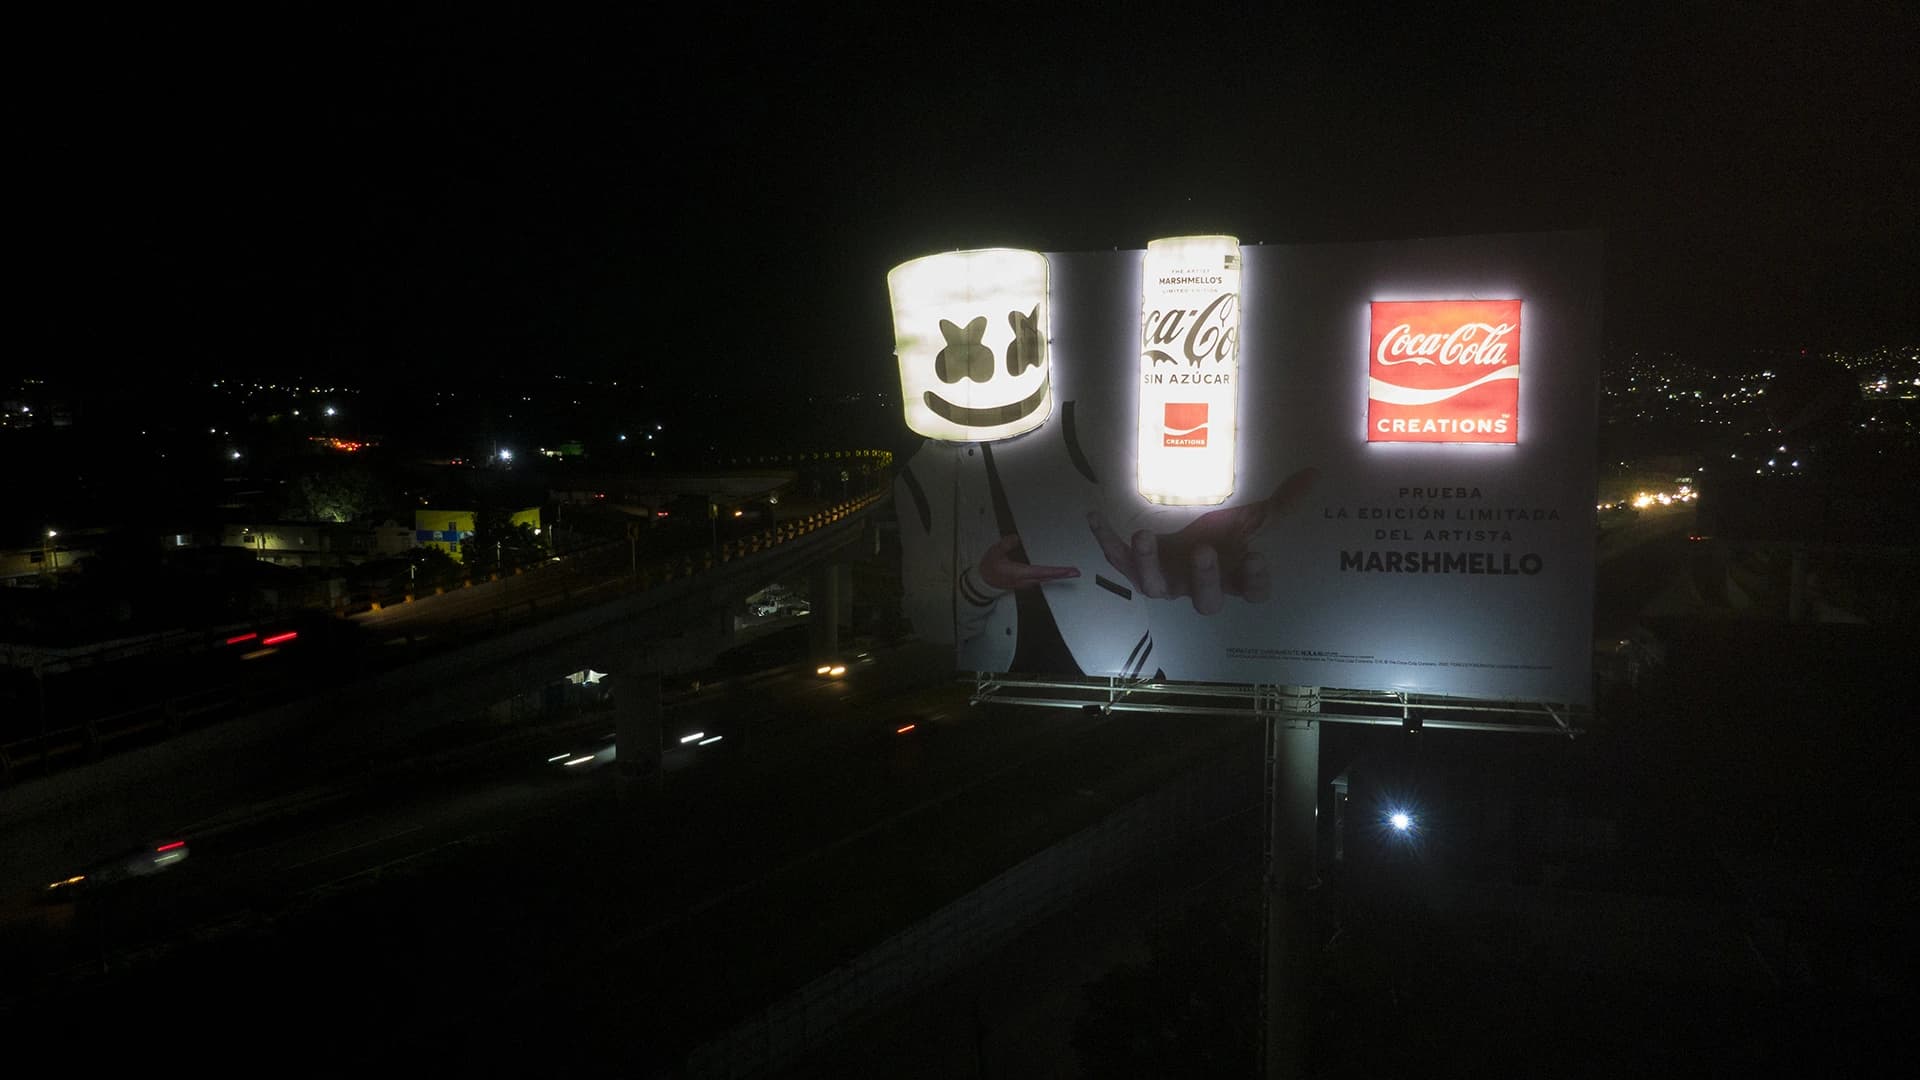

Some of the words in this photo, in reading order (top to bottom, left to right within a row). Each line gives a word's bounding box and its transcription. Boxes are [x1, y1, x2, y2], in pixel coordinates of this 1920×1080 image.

[1159, 276, 1223, 285] MARSHMELLO'S
[1377, 322, 1516, 366] Coca-Cola
[1144, 374, 1163, 384] SIN
[1168, 371, 1230, 384] AZÚCAR
[1400, 487, 1482, 498] PRUEBA
[1324, 508, 1348, 519] LA
[1358, 505, 1445, 520] EDICIÓN
[1456, 509, 1561, 521] LIMITADA
[1375, 529, 1413, 541] DEL
[1423, 530, 1513, 542] ARTISTA
[1340, 551, 1543, 575] MARSHMELLO
